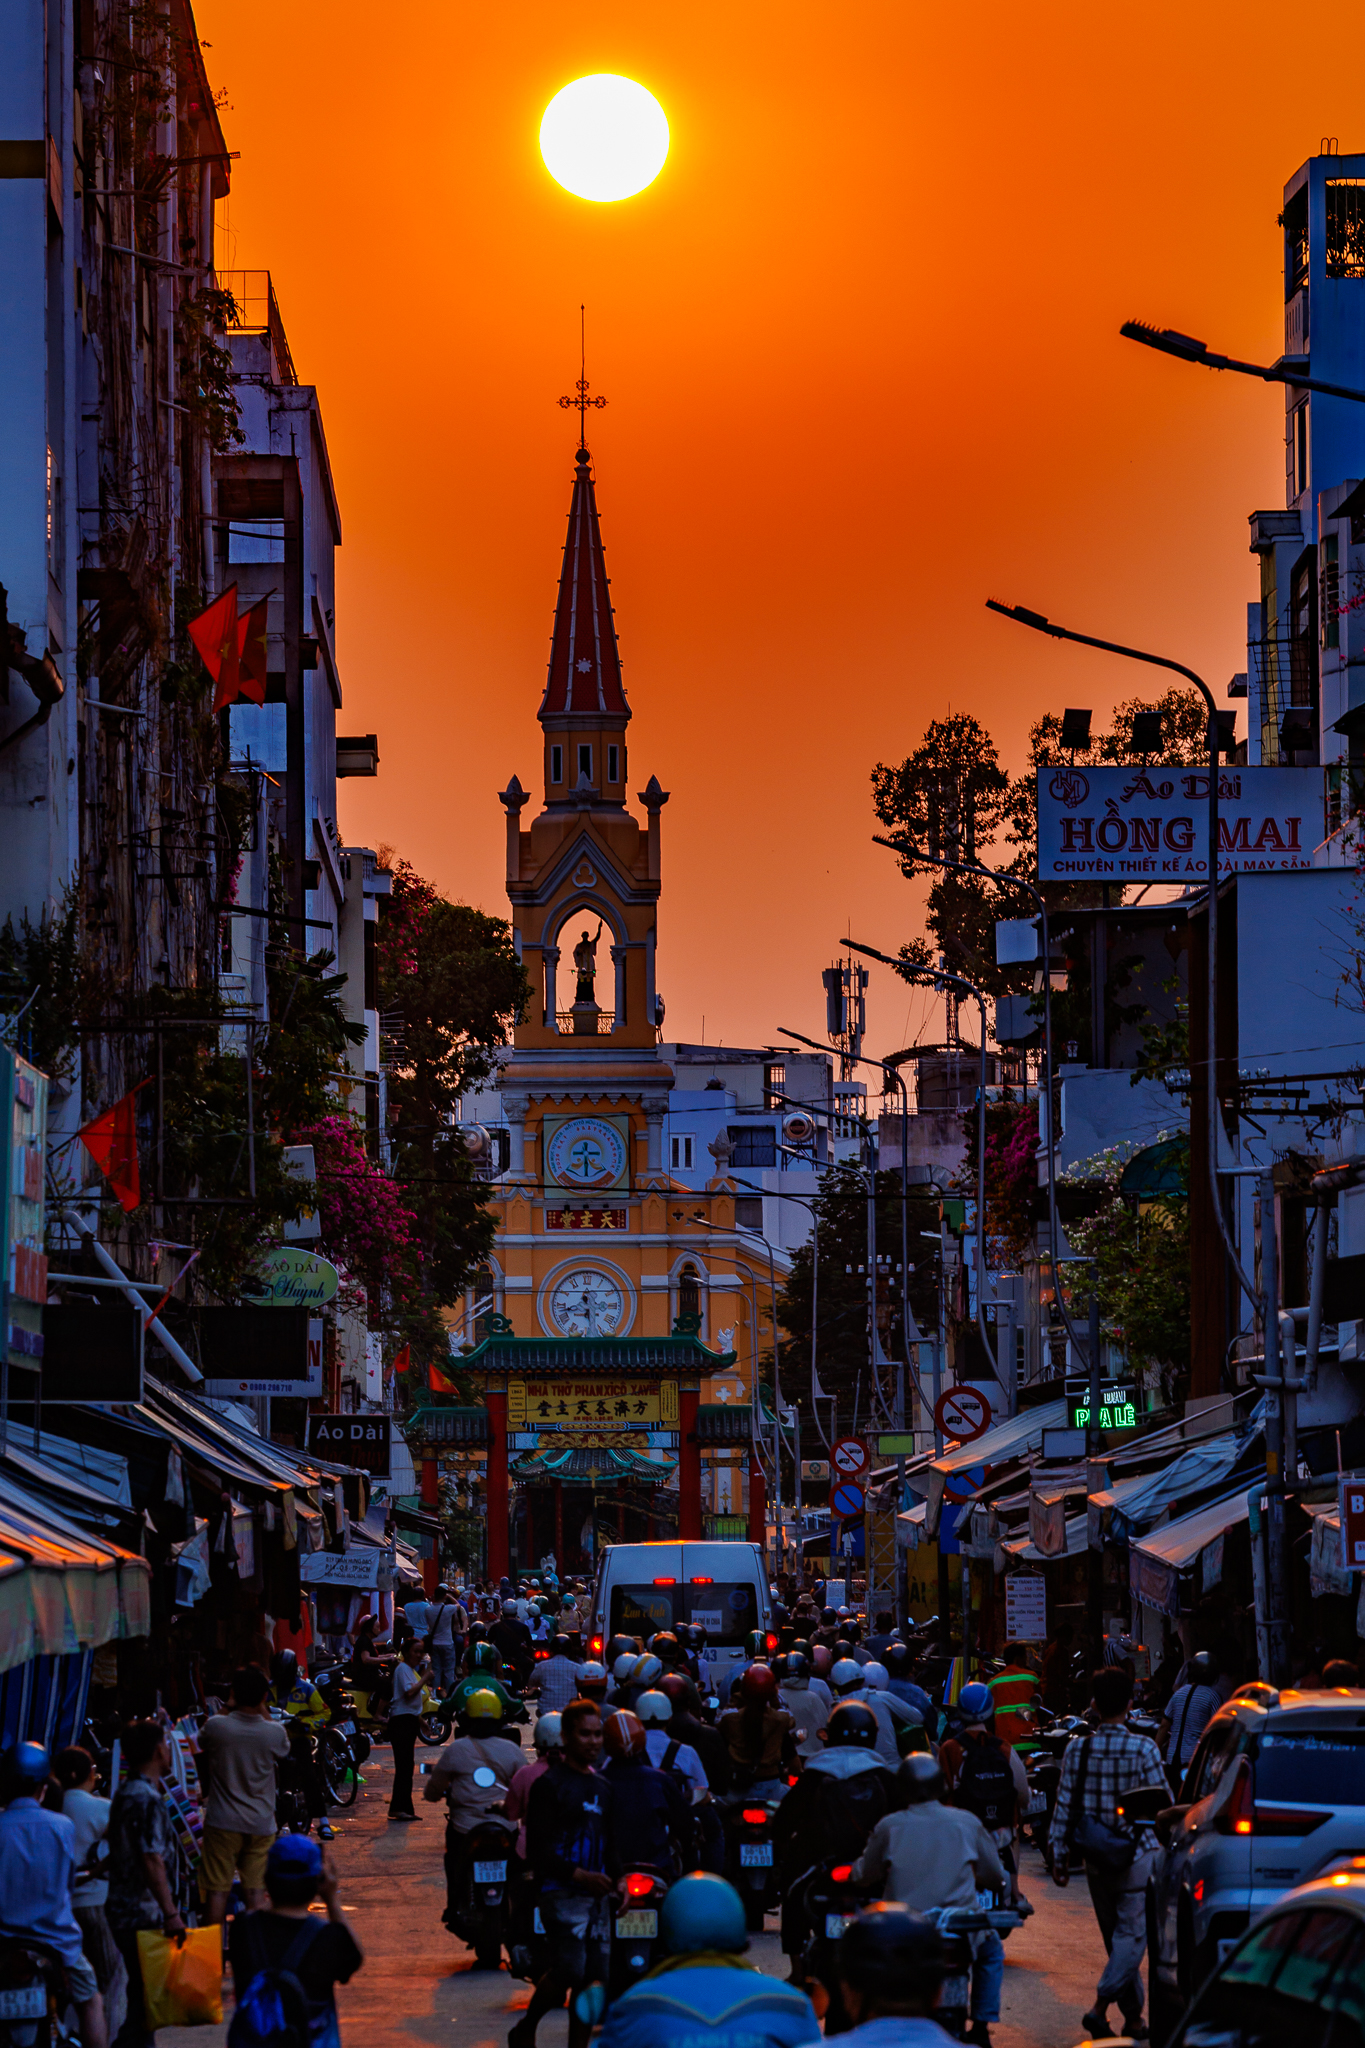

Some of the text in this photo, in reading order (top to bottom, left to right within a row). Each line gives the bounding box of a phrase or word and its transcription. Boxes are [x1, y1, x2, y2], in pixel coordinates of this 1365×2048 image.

[1120, 768, 1242, 803] Áo Dài
[1059, 798, 1302, 853] HỒNG MAI
[1053, 857, 1114, 873] CHUYÊN
[1119, 856, 1158, 873] THIẾT
[1162, 856, 1180, 873] KẾ
[1185, 857, 1208, 873] ÁO
[1244, 860, 1276, 870] MAY
[560, 1210, 616, 1229] 天主堂
[271, 1260, 319, 1274] ÁO DÀI
[274, 1275, 325, 1305] Huỳnh
[249, 1383, 267, 1392] 0908
[281, 1384, 292, 1392] 710
[528, 1380, 549, 1396] NHÀ
[551, 1380, 573, 1396] THỜ
[1075, 1402, 1136, 1428] PA LÊ
[316, 1420, 383, 1440] Áo Dài
[486, 1598, 494, 1613] 3
